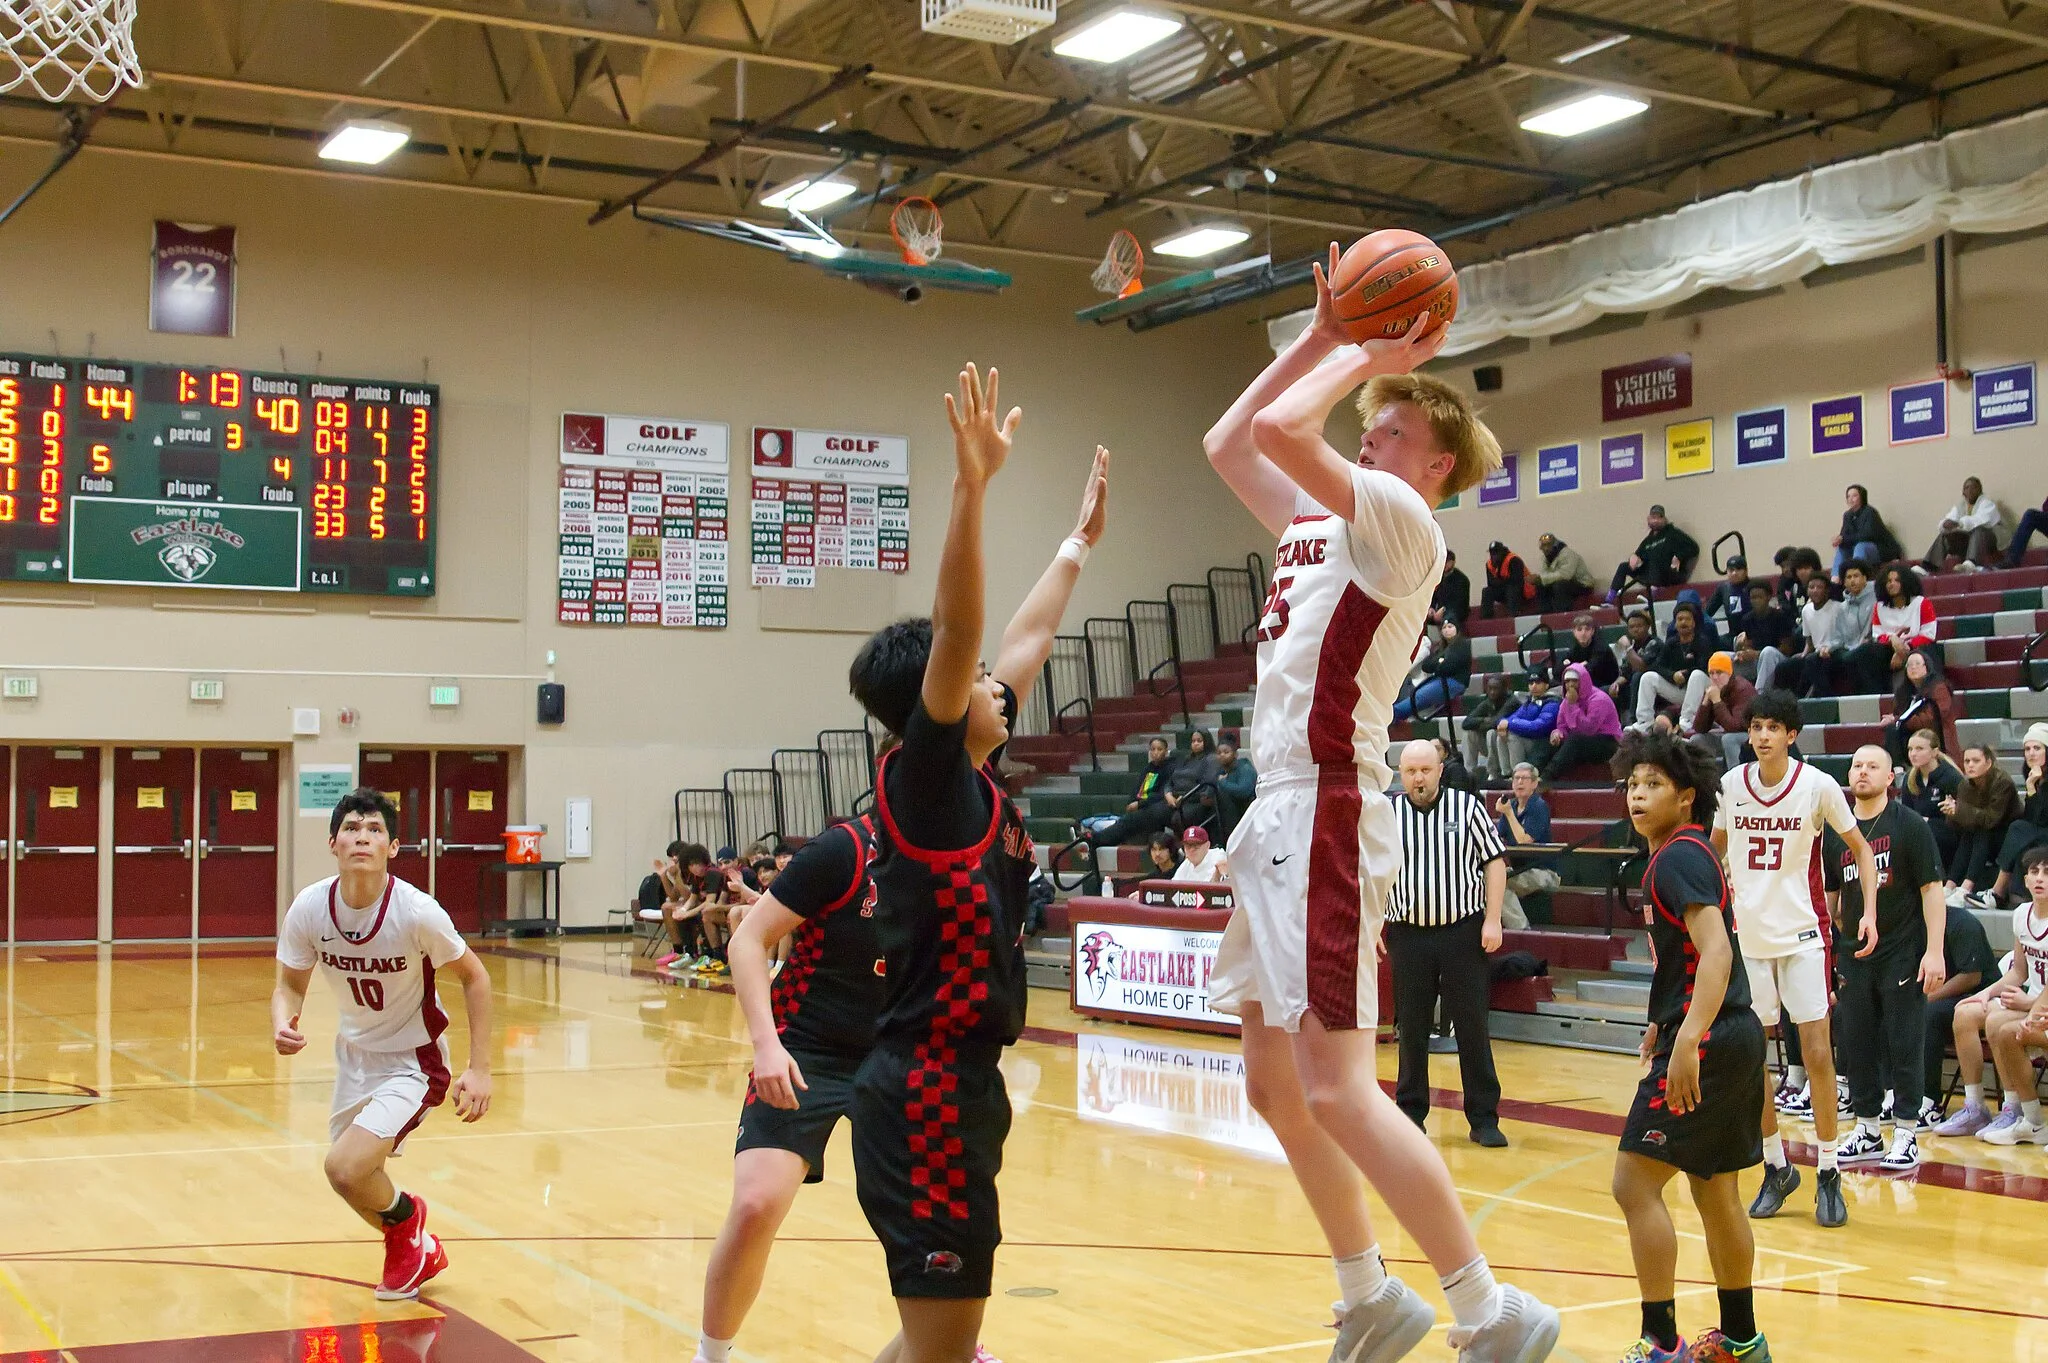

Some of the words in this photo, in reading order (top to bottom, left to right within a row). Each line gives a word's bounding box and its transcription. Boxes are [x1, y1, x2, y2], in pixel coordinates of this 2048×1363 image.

[172, 260, 217, 292] 22
[30, 361, 66, 380] fouls
[86, 363, 126, 383] Home
[1615, 367, 1675, 391] VISITING
[252, 376, 298, 395] Guests
[311, 382, 349, 399] player
[354, 385, 391, 402] points
[400, 388, 431, 406] fouls
[1993, 379, 2014, 393] LAKE
[53, 383, 63, 408] 1
[87, 385, 135, 421] 44
[1616, 382, 1677, 409] PARENTS
[41, 409, 62, 437] 0
[256, 397, 300, 434] 40
[316, 401, 348, 428] 03
[366, 405, 388, 430] 11
[412, 408, 427, 433] 3
[169, 426, 211, 443] period
[225, 422, 242, 450] 3
[638, 424, 698, 442] GOLF
[42, 438, 62, 466] 3
[315, 428, 347, 454] 04
[373, 432, 387, 456] 7
[411, 434, 426, 460] 2
[626, 442, 709, 457] CHAMPIONS
[825, 437, 880, 453] GOLF
[91, 444, 113, 473] 5
[813, 456, 890, 469] CHAMPIONS
[274, 455, 291, 481] 4
[324, 458, 346, 481] 11
[373, 459, 387, 484] 7
[410, 462, 425, 487] 2
[41, 467, 61, 494] 0
[80, 474, 114, 493] fouls
[167, 479, 212, 499] player
[262, 485, 294, 503] fouls
[314, 483, 345, 510] 23
[370, 486, 386, 513] 2
[411, 489, 425, 515] 3
[850, 496, 875, 505] 2002
[39, 496, 59, 523] 2
[155, 505, 188, 517] Home
[190, 507, 201, 518] of
[202, 508, 220, 519] the
[563, 499, 591, 510] 2005
[631, 504, 659, 514] 2006
[755, 511, 781, 520] 2013
[881, 518, 906, 527] 2014
[130, 517, 246, 550] Eastlake
[314, 511, 345, 538] 33
[369, 514, 385, 540] 5
[418, 517, 425, 541] 1
[597, 525, 625, 534] 2008
[666, 527, 692, 538] 2011
[754, 533, 781, 542] 2014
[562, 544, 592, 556] 2012
[597, 546, 625, 556] 2012
[665, 550, 692, 560] 2013
[699, 551, 726, 561] 2013
[850, 558, 875, 567] 2016
[881, 560, 907, 570] 2017
[698, 574, 725, 582] 2016
[755, 576, 781, 584] 2017
[786, 577, 812, 586] 2017
[561, 589, 591, 600] 2017
[595, 590, 624, 601] 2017
[631, 592, 658, 602] 2017
[665, 593, 692, 602] 2017
[1257, 576, 1295, 641] 25
[665, 615, 693, 625] 2022
[9, 679, 32, 695] EXIT
[197, 682, 218, 697] EXIT
[1734, 816, 1802, 831] EASTLAKE
[1748, 836, 1784, 871] 23
[1179, 892, 1197, 907] POSS
[1183, 937, 1219, 949] WELCOM
[322, 951, 408, 974] EASTLAKE
[1120, 950, 1196, 989] EASTLAKE
[2035, 960, 2047, 985] 4
[347, 976, 384, 1012] 10
[1123, 987, 1168, 1008] HOME
[1173, 992, 1194, 1011] OF
